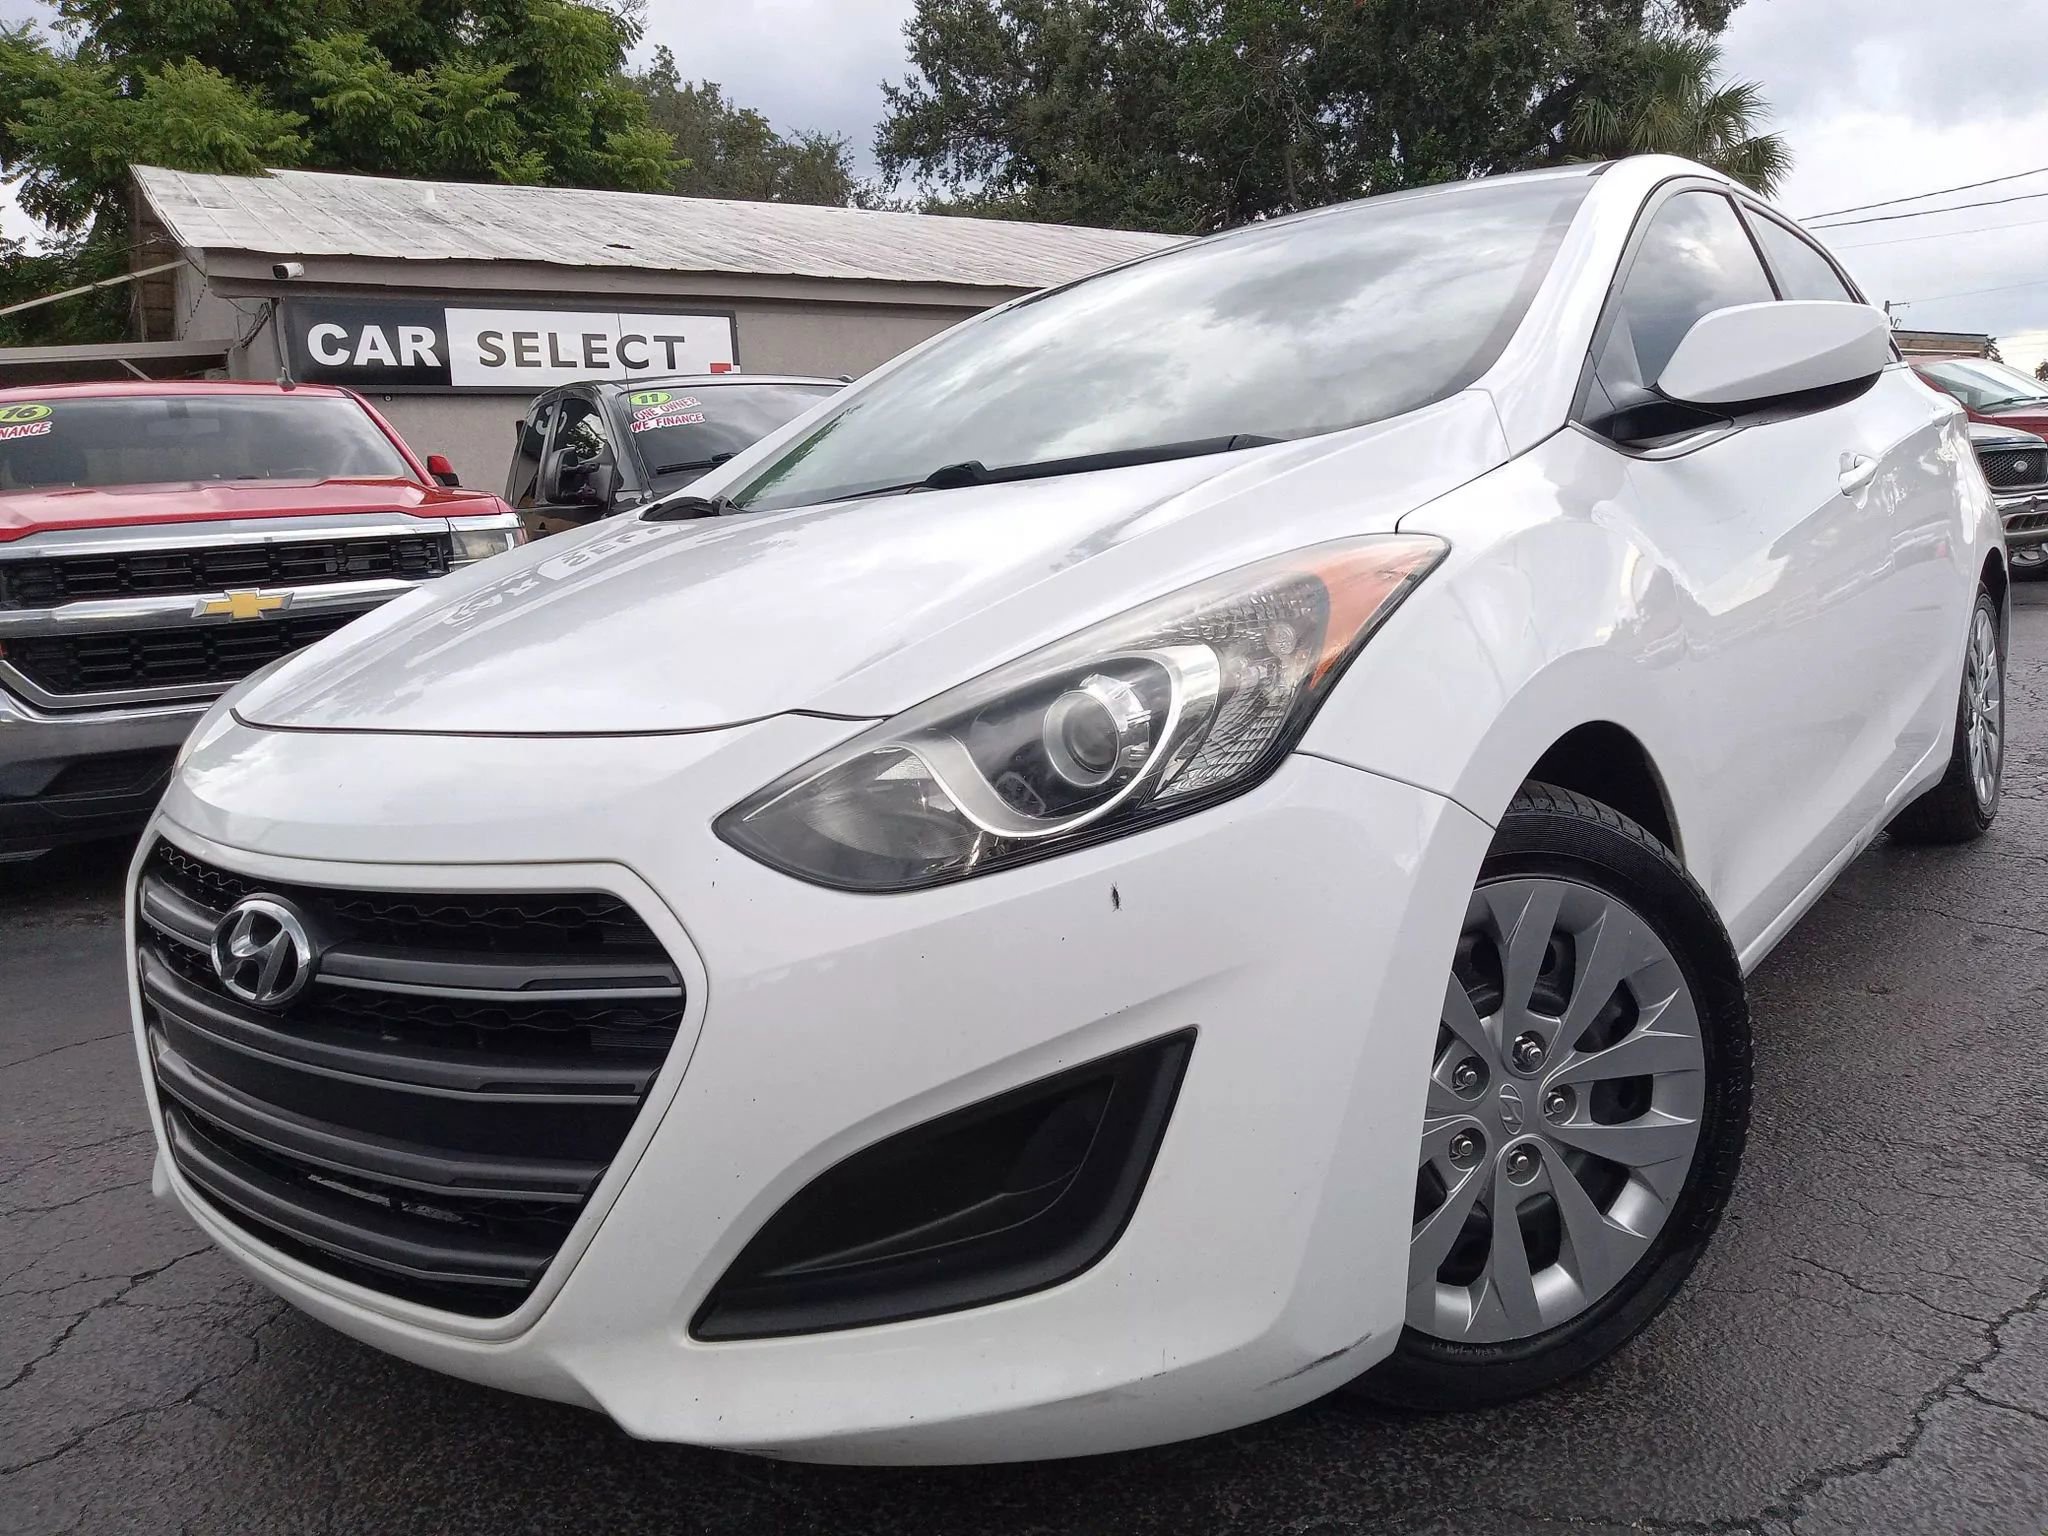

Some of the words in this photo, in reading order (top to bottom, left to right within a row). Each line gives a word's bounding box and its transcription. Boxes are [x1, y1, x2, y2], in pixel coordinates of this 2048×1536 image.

[307, 323, 442, 367] CAR
[478, 330, 685, 370] SELECT
[638, 393, 659, 404] 11
[2, 406, 40, 419] 16
[634, 408, 659, 421] ONE
[660, 397, 698, 413] OWNER
[631, 421, 650, 432] WE
[655, 413, 704, 427] FINANCE
